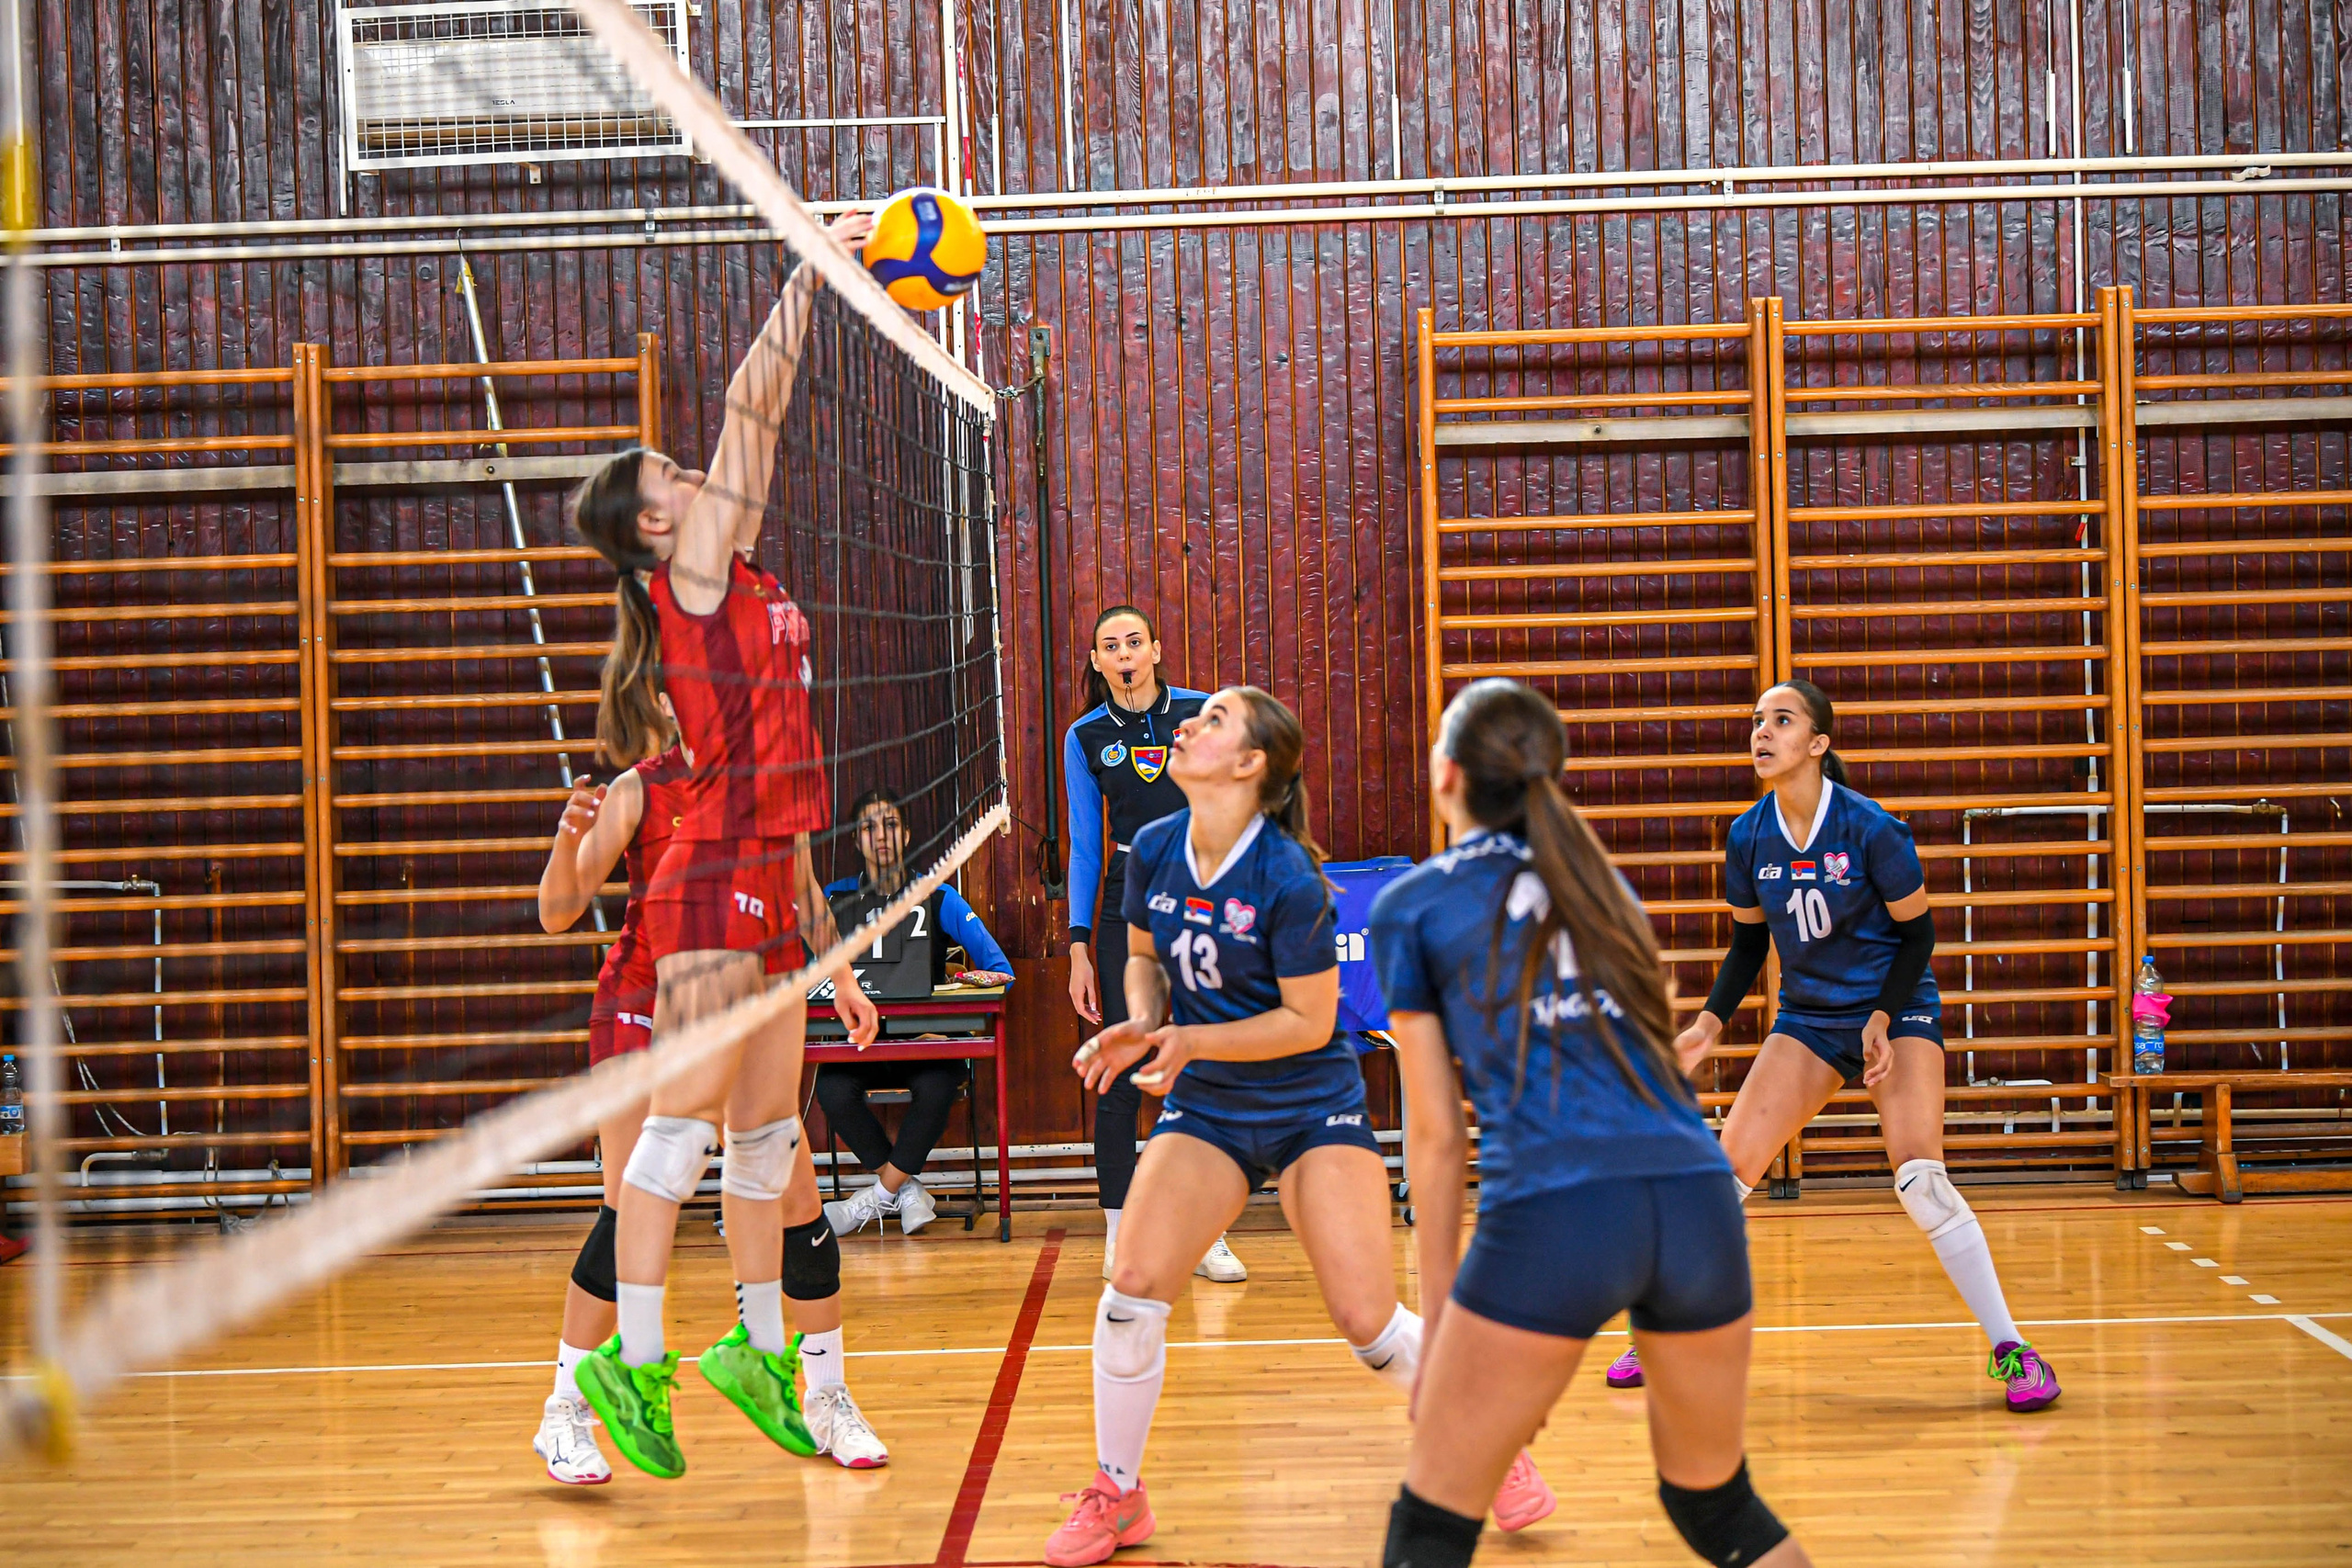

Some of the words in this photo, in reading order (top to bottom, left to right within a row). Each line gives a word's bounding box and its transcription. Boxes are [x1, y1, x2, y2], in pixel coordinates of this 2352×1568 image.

[865, 906, 883, 959] 1
[910, 905, 928, 938] 2
[1786, 887, 1832, 942] 10
[1170, 928, 1223, 992] 13
